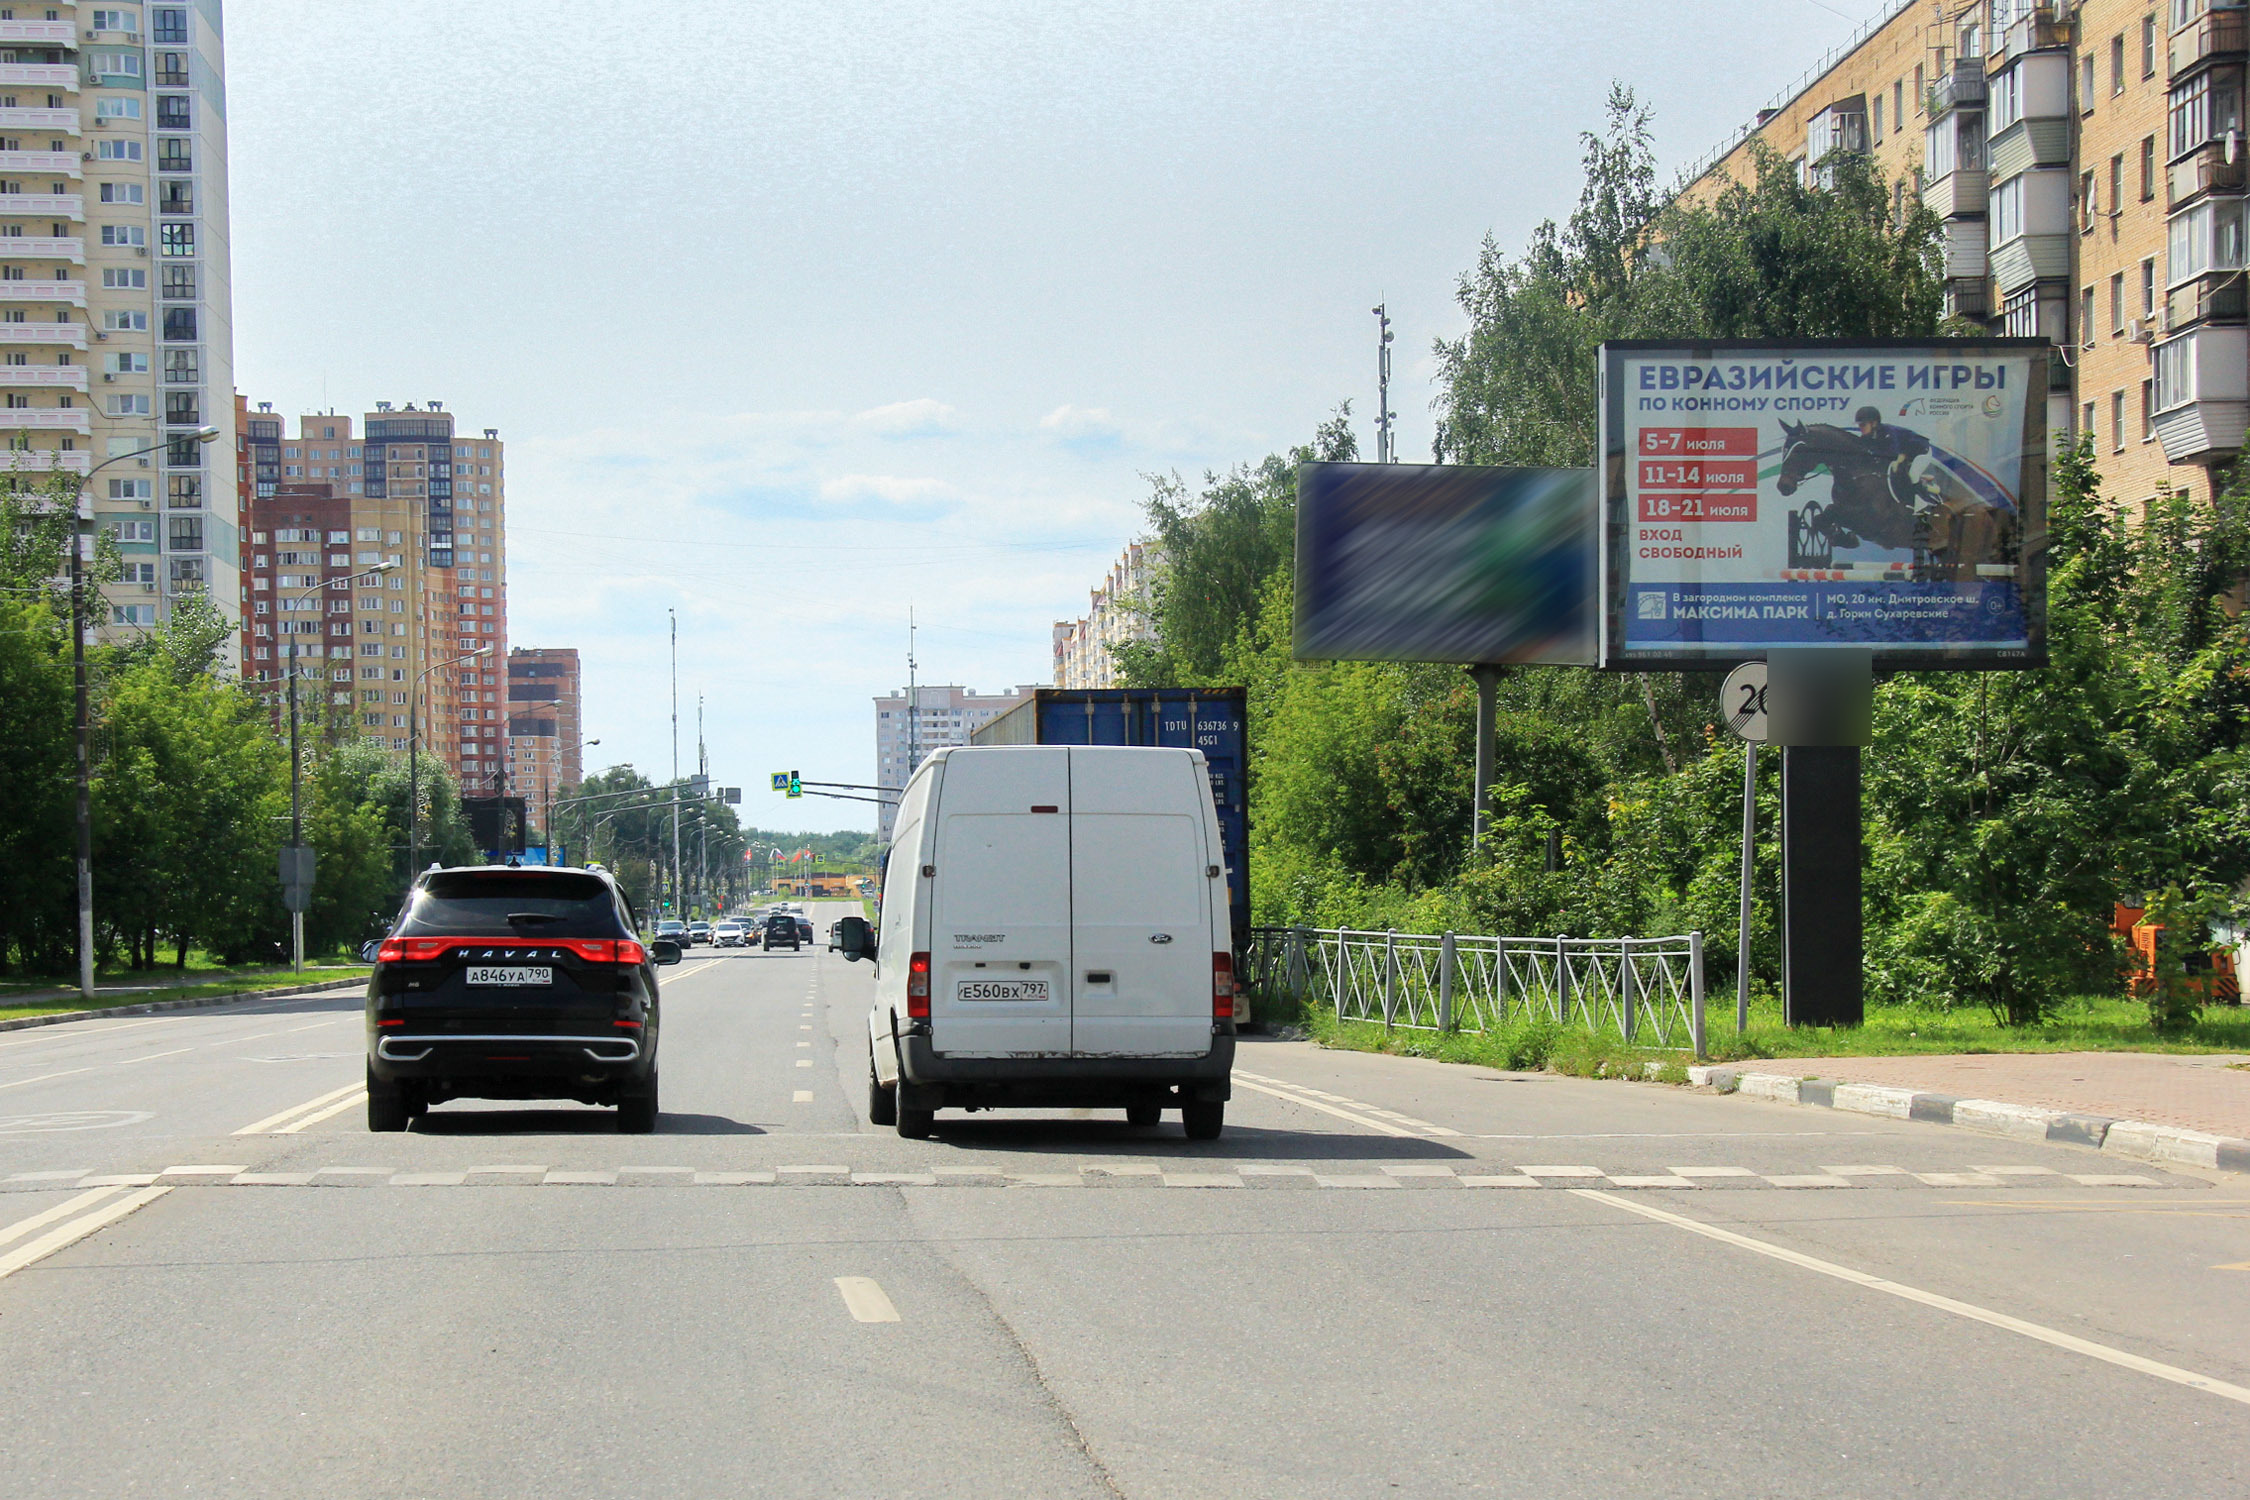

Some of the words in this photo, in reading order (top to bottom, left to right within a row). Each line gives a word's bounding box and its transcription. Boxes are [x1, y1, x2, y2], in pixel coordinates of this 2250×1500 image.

[1639, 359, 1895, 390] ЕВРАЗИЙСКИЕ
[1907, 365, 2005, 390] ИГРЫ
[1639, 397, 1666, 411] ПО
[1672, 397, 1767, 411] КОННОМУ
[1774, 396, 1850, 411] СПОРТУ
[1646, 432, 1682, 451] 5-7
[1645, 466, 1700, 484] 11-14
[1647, 499, 1704, 516] 18-21
[1640, 529, 1682, 541] ВХОД
[1640, 544, 1742, 559] СВОБОДНЫЙ
[1673, 593, 1680, 602] В
[1683, 593, 1746, 604] загородном
[1749, 594, 1807, 602] комплексе
[1851, 593, 1866, 604] 20
[1889, 593, 1963, 606] Дмитровское
[1966, 595, 1979, 604] ш.
[1673, 606, 1760, 619] МАКСИМА
[1763, 605, 1809, 619] ПАРК
[1826, 611, 1837, 620] д.
[1840, 608, 1872, 620] Горки
[1874, 608, 1949, 621] Сухаревские
[1197, 720, 1227, 731] 636736
[1233, 721, 1239, 731] 9
[1198, 735, 1218, 745] 45G1
[458, 950, 561, 958] HAVAL
[528, 968, 549, 978] 790
[1022, 983, 1045, 994] 797
